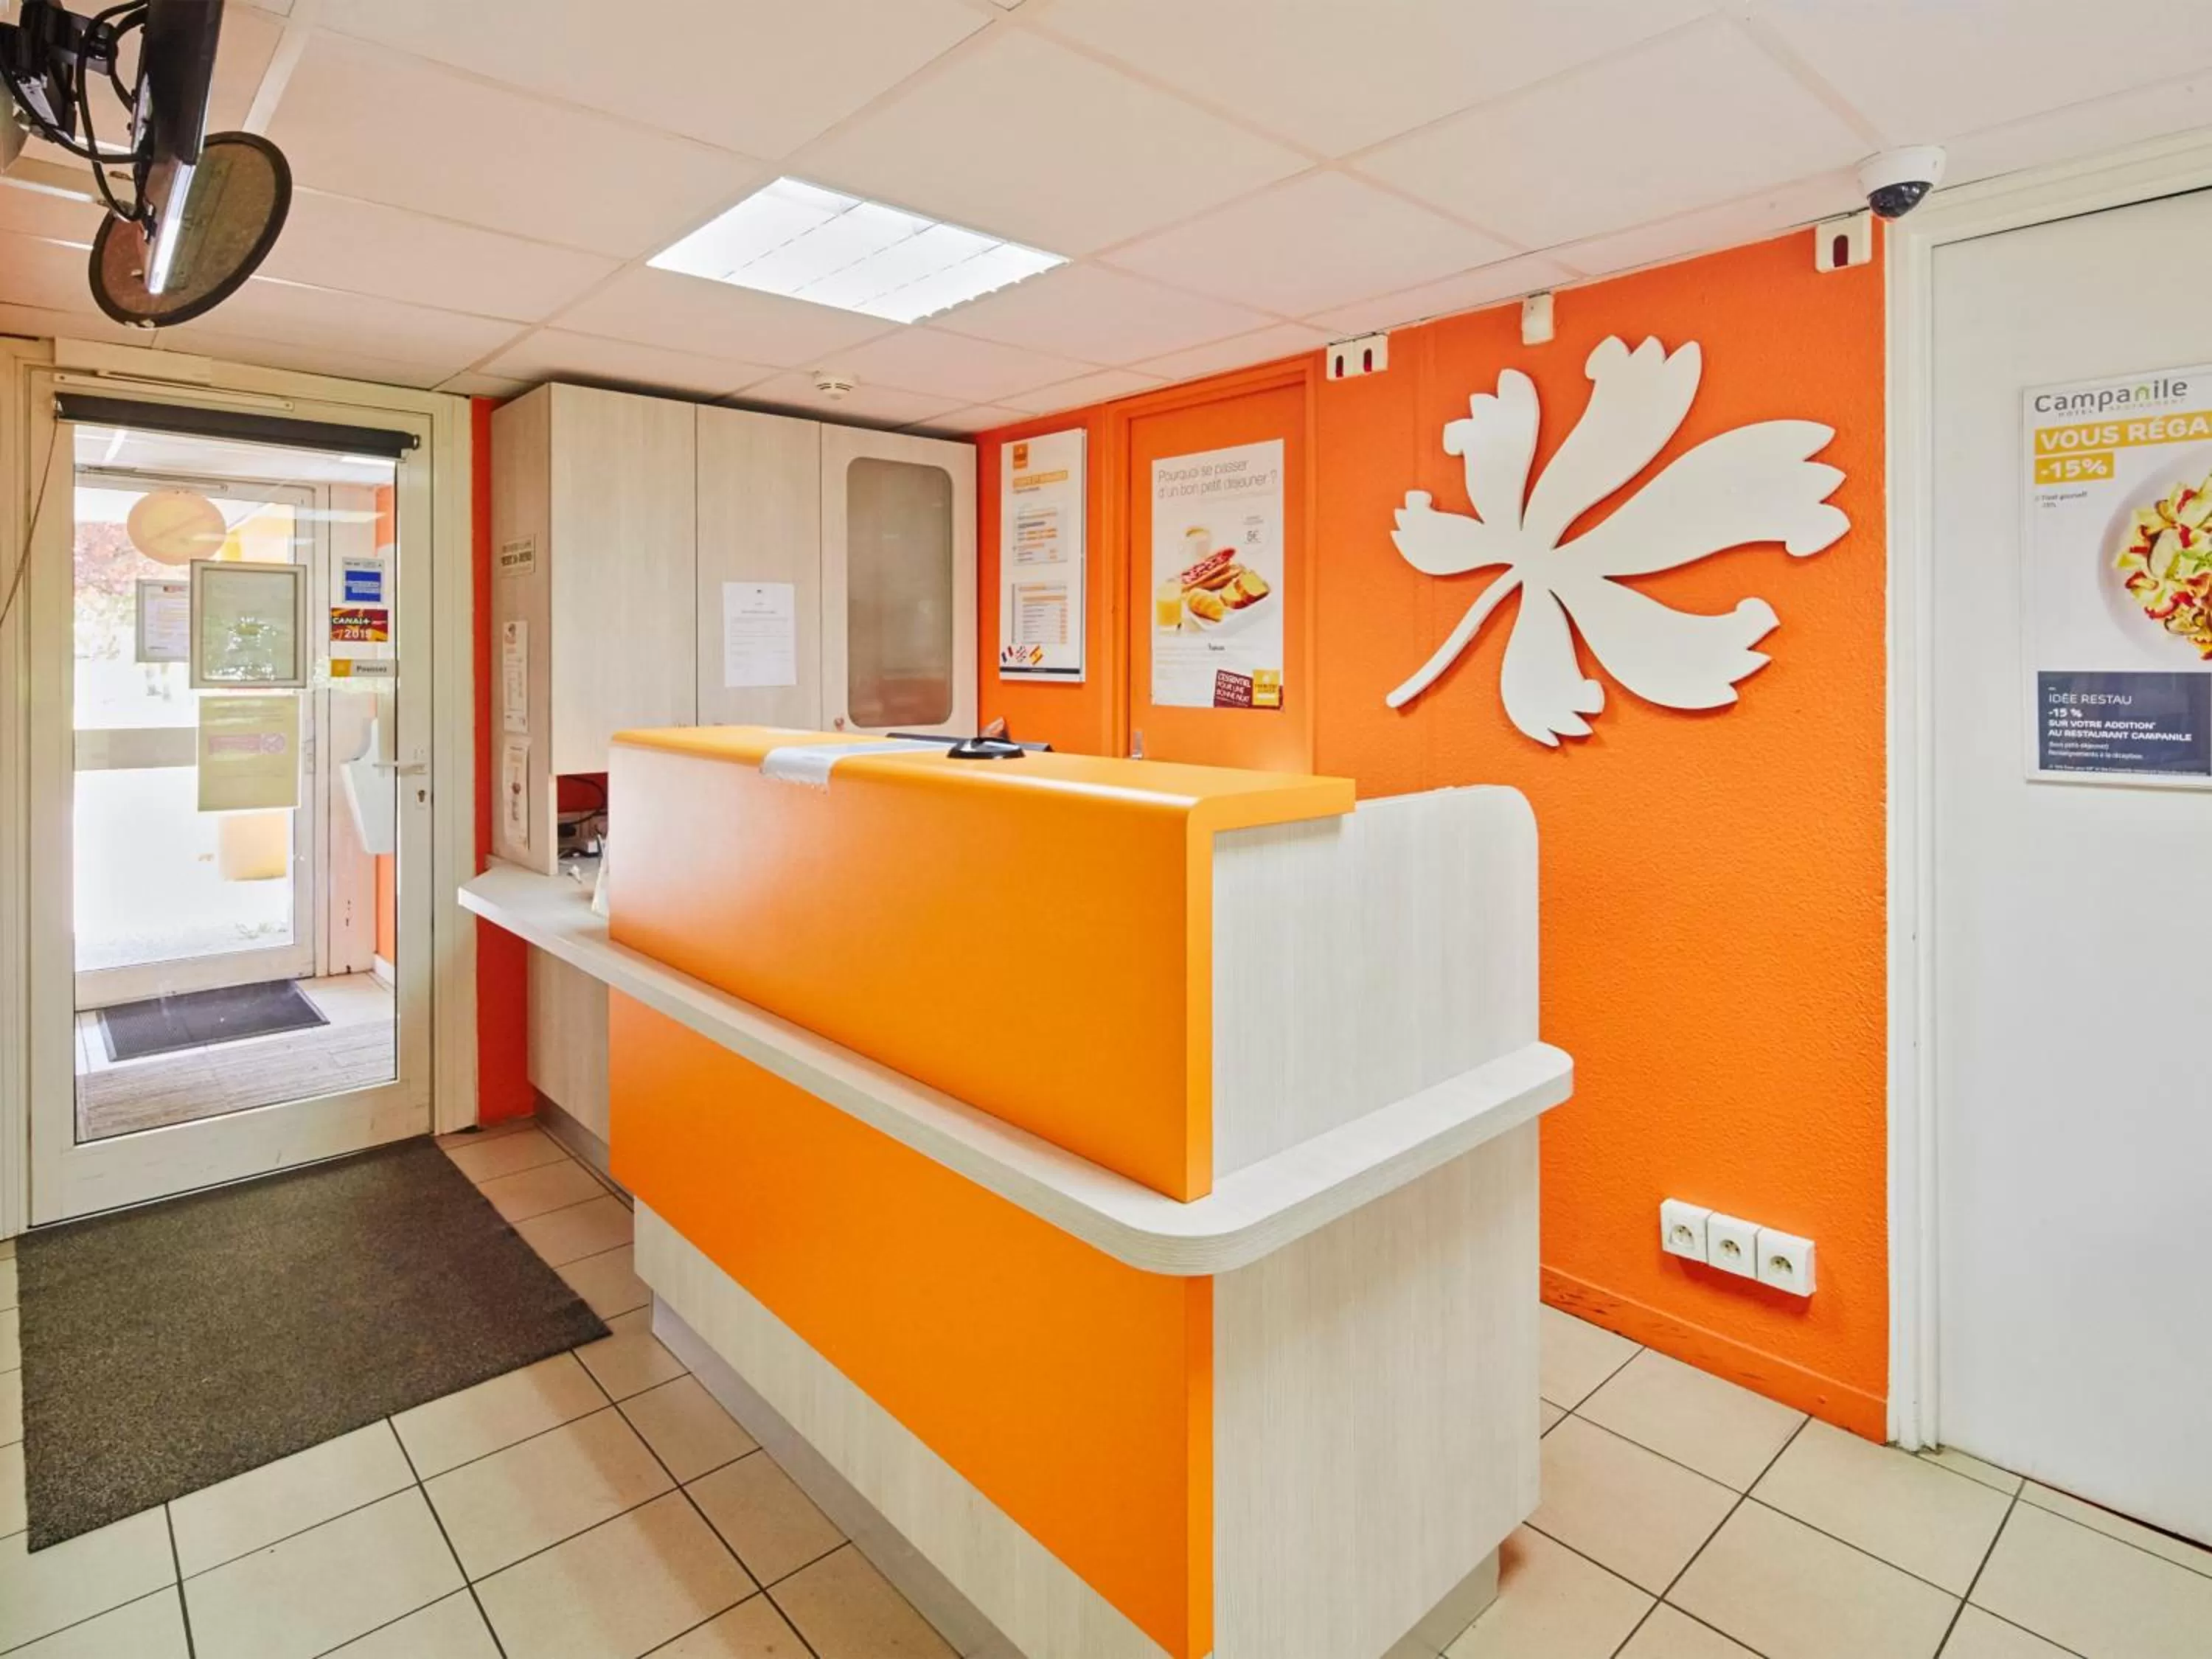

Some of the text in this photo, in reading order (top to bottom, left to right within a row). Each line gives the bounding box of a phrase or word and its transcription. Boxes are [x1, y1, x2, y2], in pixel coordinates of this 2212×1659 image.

[2034, 378, 2188, 413] Campanile
[2040, 425, 2121, 451] VOUS
[1201, 465, 1213, 476] se
[1214, 459, 1249, 479] passer
[2040, 458, 2108, 479] -15%
[1180, 483, 1199, 496] bon
[333, 617, 371, 625] CANAL+
[2048, 692, 2132, 705] IDÉE RESTAU
[2048, 708, 2083, 718] -15 %
[2048, 719, 2068, 728] SUR
[2070, 720, 2103, 728] VOTRE
[2048, 728, 2193, 742] AU RESTAURANT CAMPANILE
